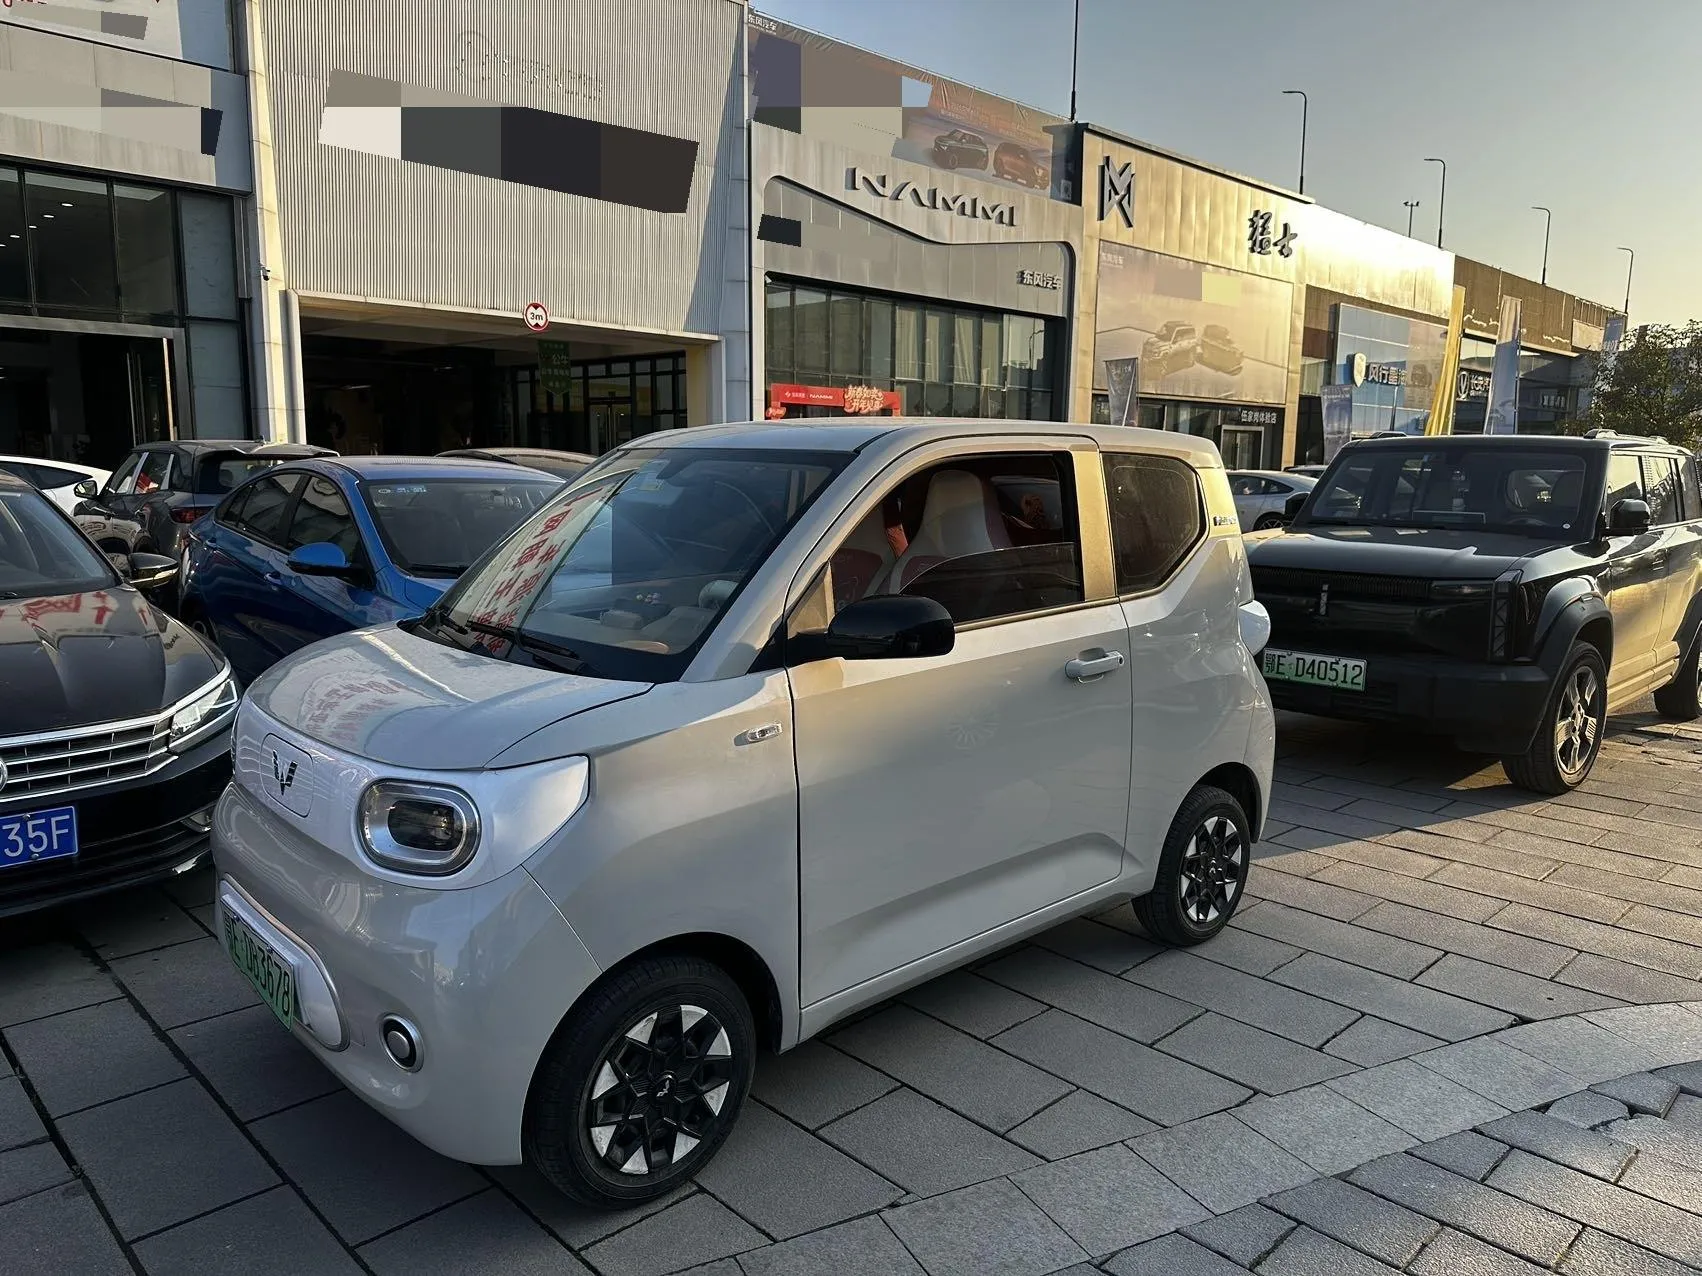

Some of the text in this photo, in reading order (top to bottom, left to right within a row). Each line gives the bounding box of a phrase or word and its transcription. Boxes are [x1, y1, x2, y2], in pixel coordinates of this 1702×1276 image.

[845, 167, 1017, 227] NAMMI
[1023, 270, 1062, 289] 东风汽车
[530, 312, 543, 321] 3m
